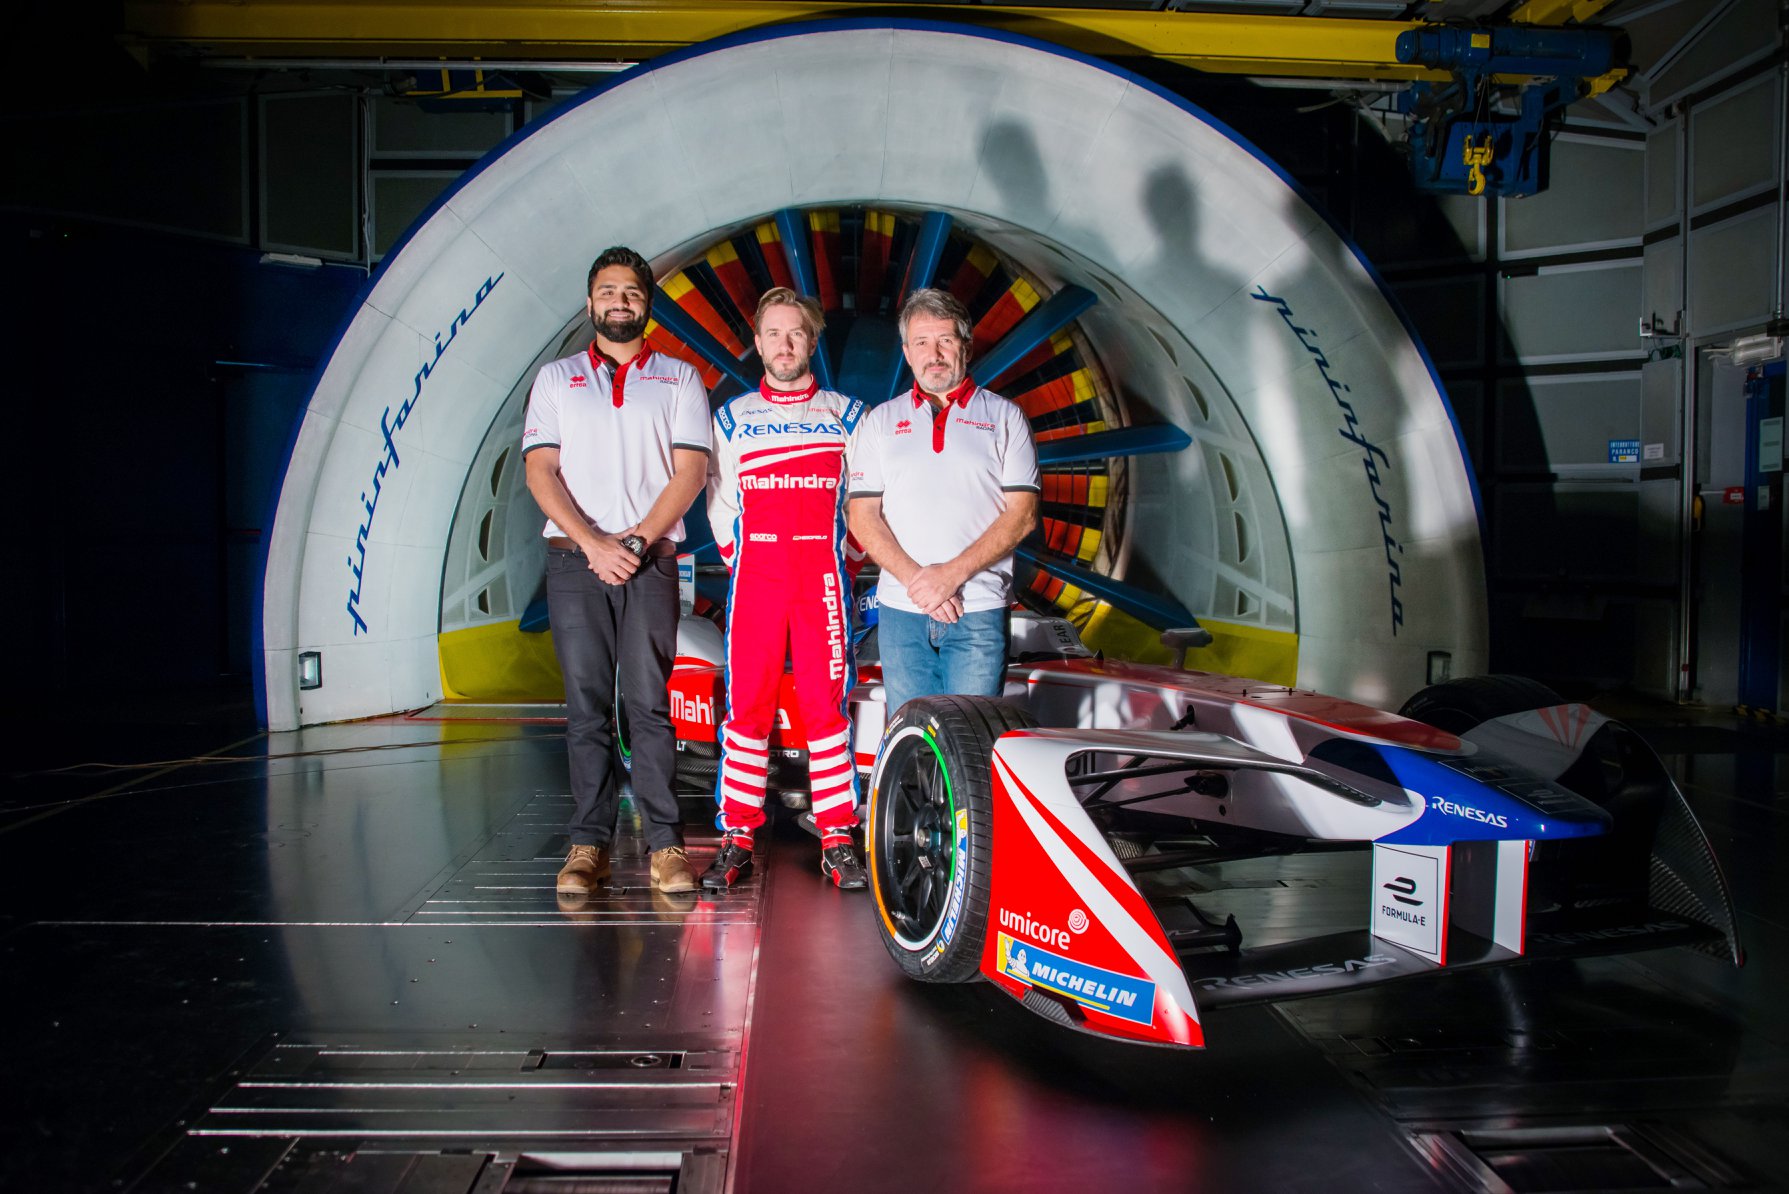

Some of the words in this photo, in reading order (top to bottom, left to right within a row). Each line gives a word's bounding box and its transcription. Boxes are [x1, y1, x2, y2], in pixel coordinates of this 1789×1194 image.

[771, 393, 809, 403] Mahindra
[738, 422, 842, 439] RENESAS
[741, 474, 837, 490] Mahindra
[823, 573, 843, 680] Mahindra
[1432, 796, 1508, 828] RENESAS
[944, 850, 967, 939] MICHELIN
[1000, 908, 1071, 950] umicore
[1032, 962, 1137, 1007] MICHELIN
[1193, 953, 1397, 991] RENESAS
